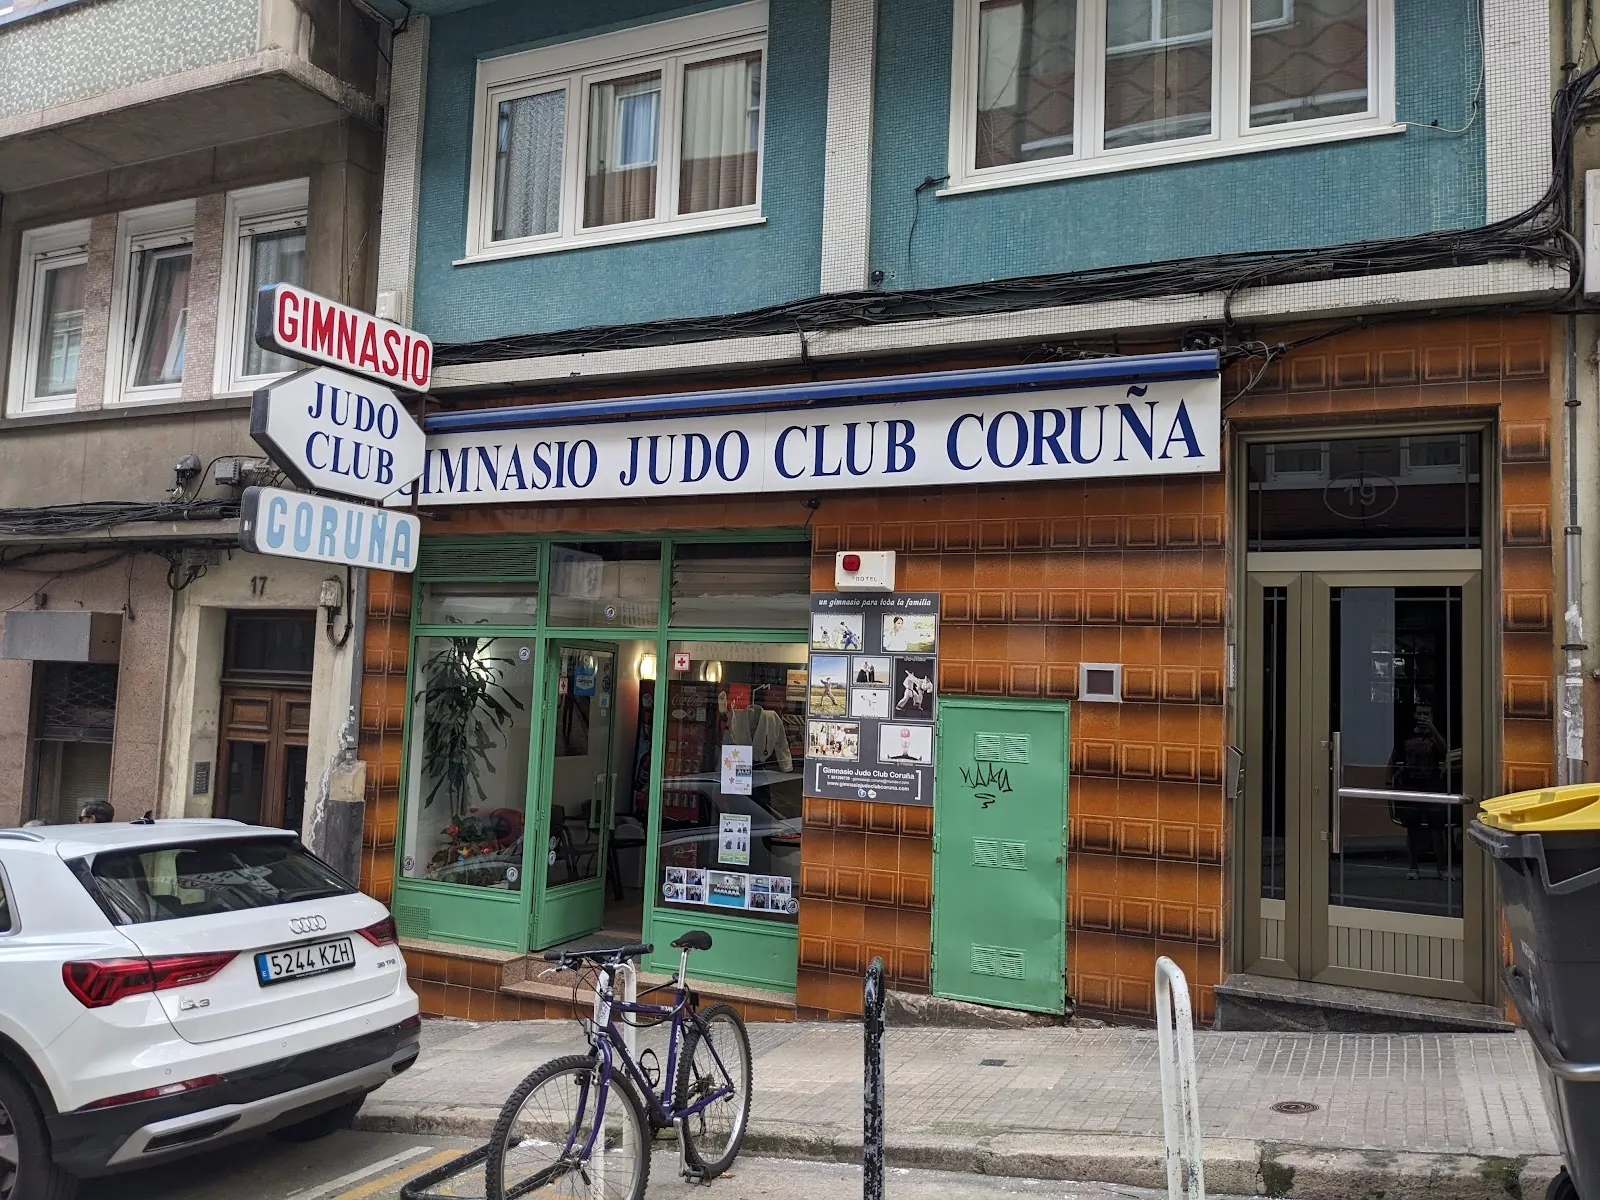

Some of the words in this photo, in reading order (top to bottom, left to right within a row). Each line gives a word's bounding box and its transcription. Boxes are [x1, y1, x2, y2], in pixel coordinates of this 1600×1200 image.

[278, 290, 430, 387] GIMNASIO
[308, 381, 399, 440] JUDO
[305, 431, 394, 485] CLUB
[398, 439, 598, 496] IMNASIO
[619, 430, 750, 486] JUDO
[774, 419, 916, 479] CLUB
[946, 384, 1206, 471] CORUÑA
[1343, 482, 1377, 506] 19
[266, 496, 412, 568] CORUÑA
[250, 575, 268, 596] 17
[818, 598, 828, 606] un
[829, 597, 860, 608] gimnasio
[861, 599, 878, 608] para
[880, 597, 895, 606] toda
[897, 598, 904, 606] la
[905, 597, 931, 608] familia
[822, 766, 854, 775] Gimnasio
[854, 768, 872, 777] Judo
[872, 769, 889, 778] Club
[889, 771, 915, 779] Coruña
[271, 949, 316, 976] 5244
[319, 942, 350, 967] KZH
